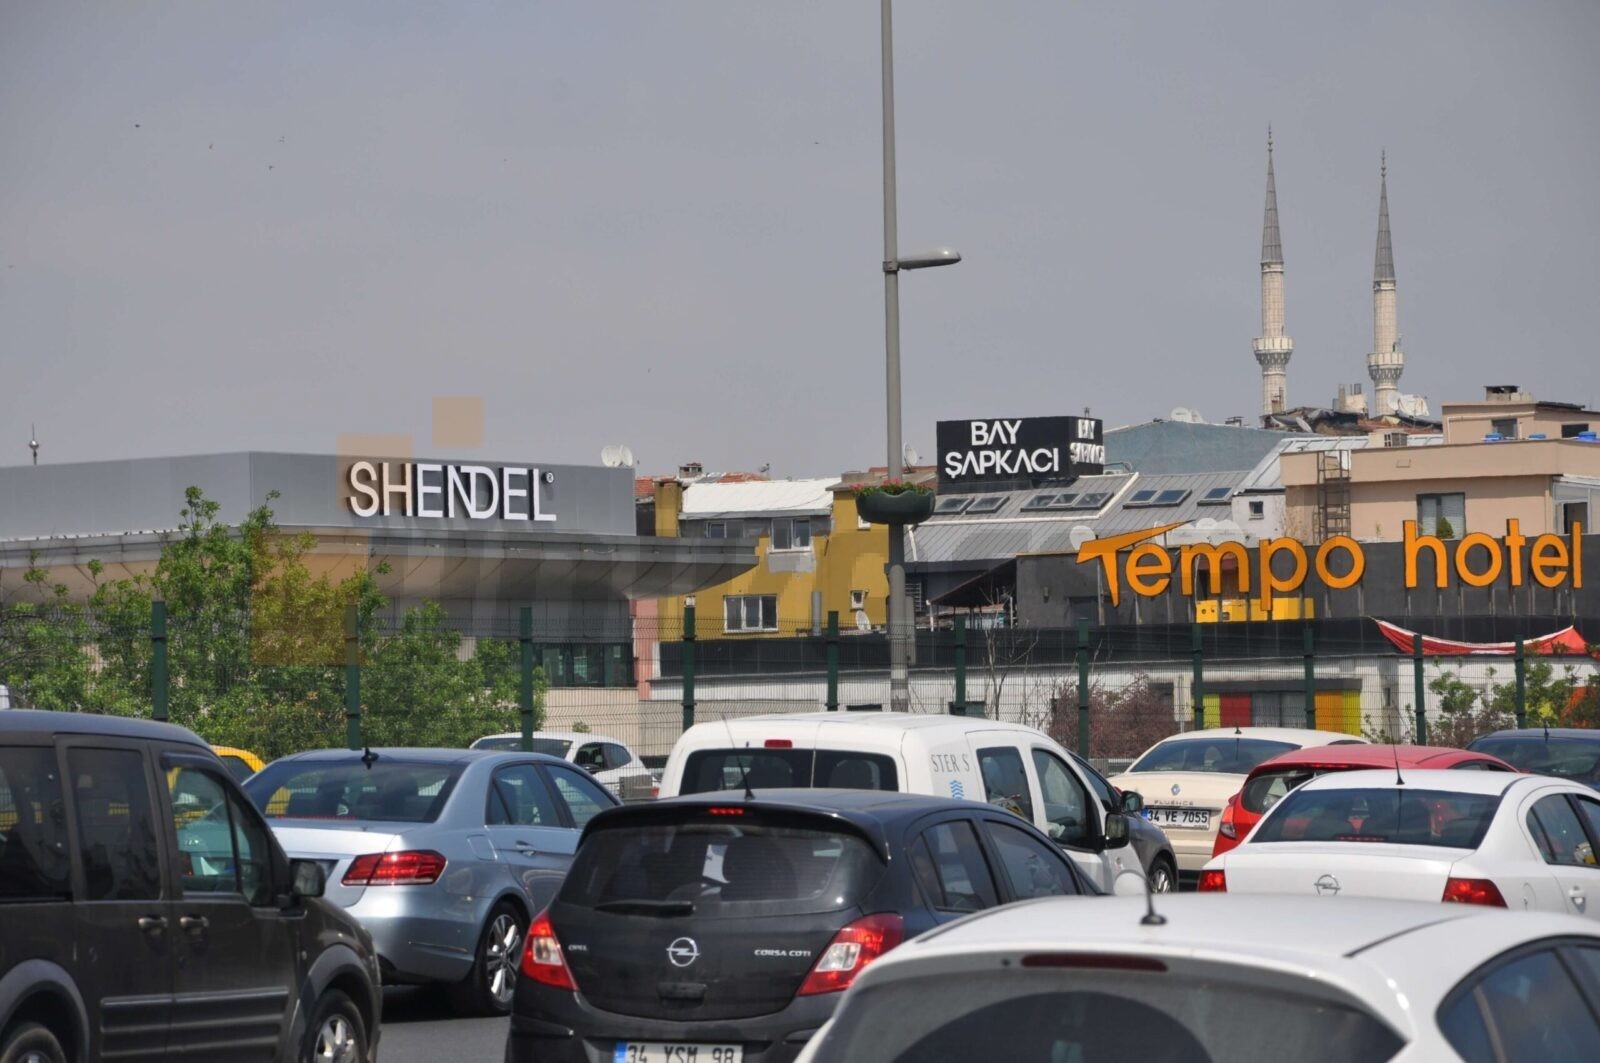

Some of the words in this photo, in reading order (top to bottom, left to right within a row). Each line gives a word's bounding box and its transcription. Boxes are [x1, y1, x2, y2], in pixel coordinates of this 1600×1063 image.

[970, 419, 1022, 446] BAY
[945, 447, 1060, 479] ŞAPKACI
[348, 461, 557, 522] SHENDEL
[1075, 519, 1365, 612] Tempo
[1402, 518, 1583, 589] hotel
[1147, 810, 1160, 822] 34
[1183, 812, 1208, 825] 7055
